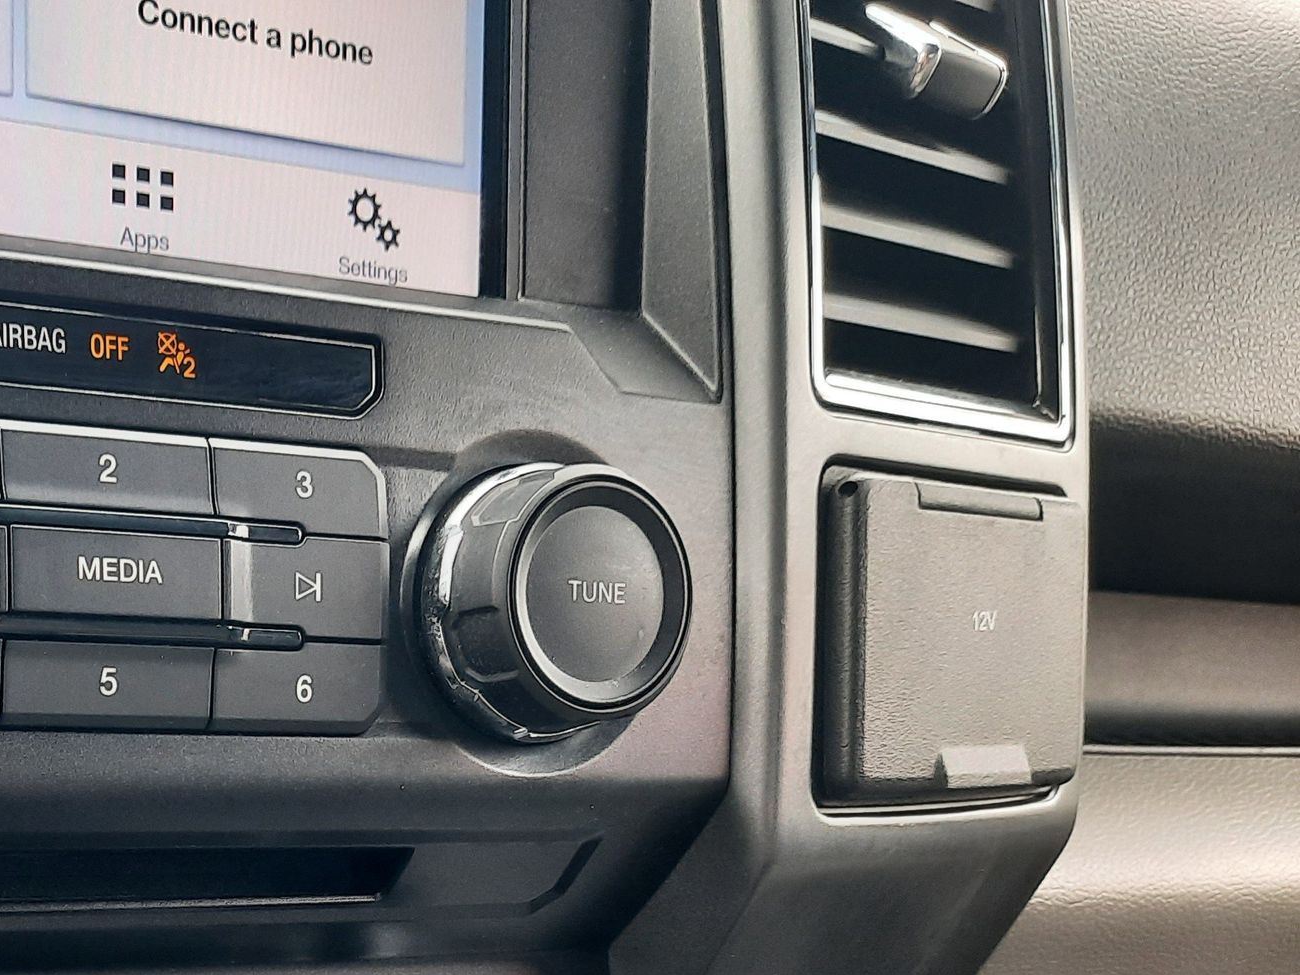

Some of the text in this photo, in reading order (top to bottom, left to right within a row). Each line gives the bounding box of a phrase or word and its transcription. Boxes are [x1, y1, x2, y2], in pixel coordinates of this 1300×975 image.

[138, 0, 374, 65] Connect a phone
[120, 227, 169, 253] Apps
[338, 256, 408, 284] Settings
[90, 333, 130, 361] OFF
[99, 454, 117, 483] 2
[296, 470, 313, 498] 3
[77, 556, 163, 584] MEDIA
[568, 580, 626, 604] TUNE
[972, 610, 998, 631] 12V
[100, 667, 118, 696] 5
[296, 675, 312, 703] 6
